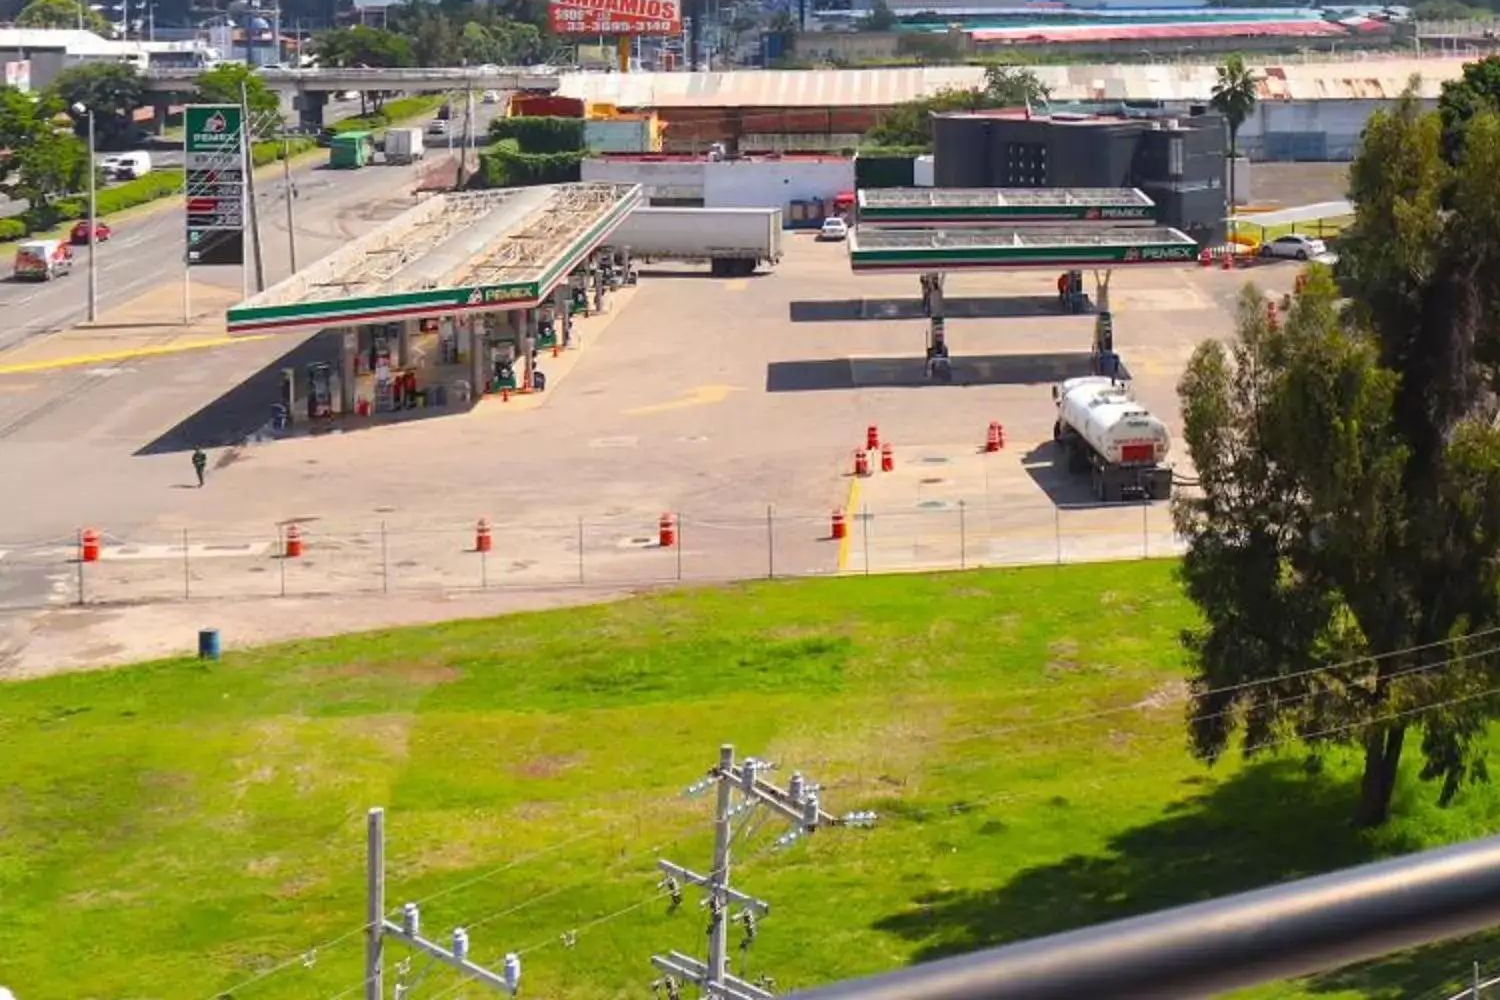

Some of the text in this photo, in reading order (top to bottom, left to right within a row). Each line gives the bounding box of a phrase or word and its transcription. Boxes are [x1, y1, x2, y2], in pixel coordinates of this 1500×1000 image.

[193, 133, 236, 142] PEMEX
[1101, 207, 1146, 217] PEMEX
[1142, 247, 1192, 259] PEMEX
[485, 285, 533, 301] PEMEX
